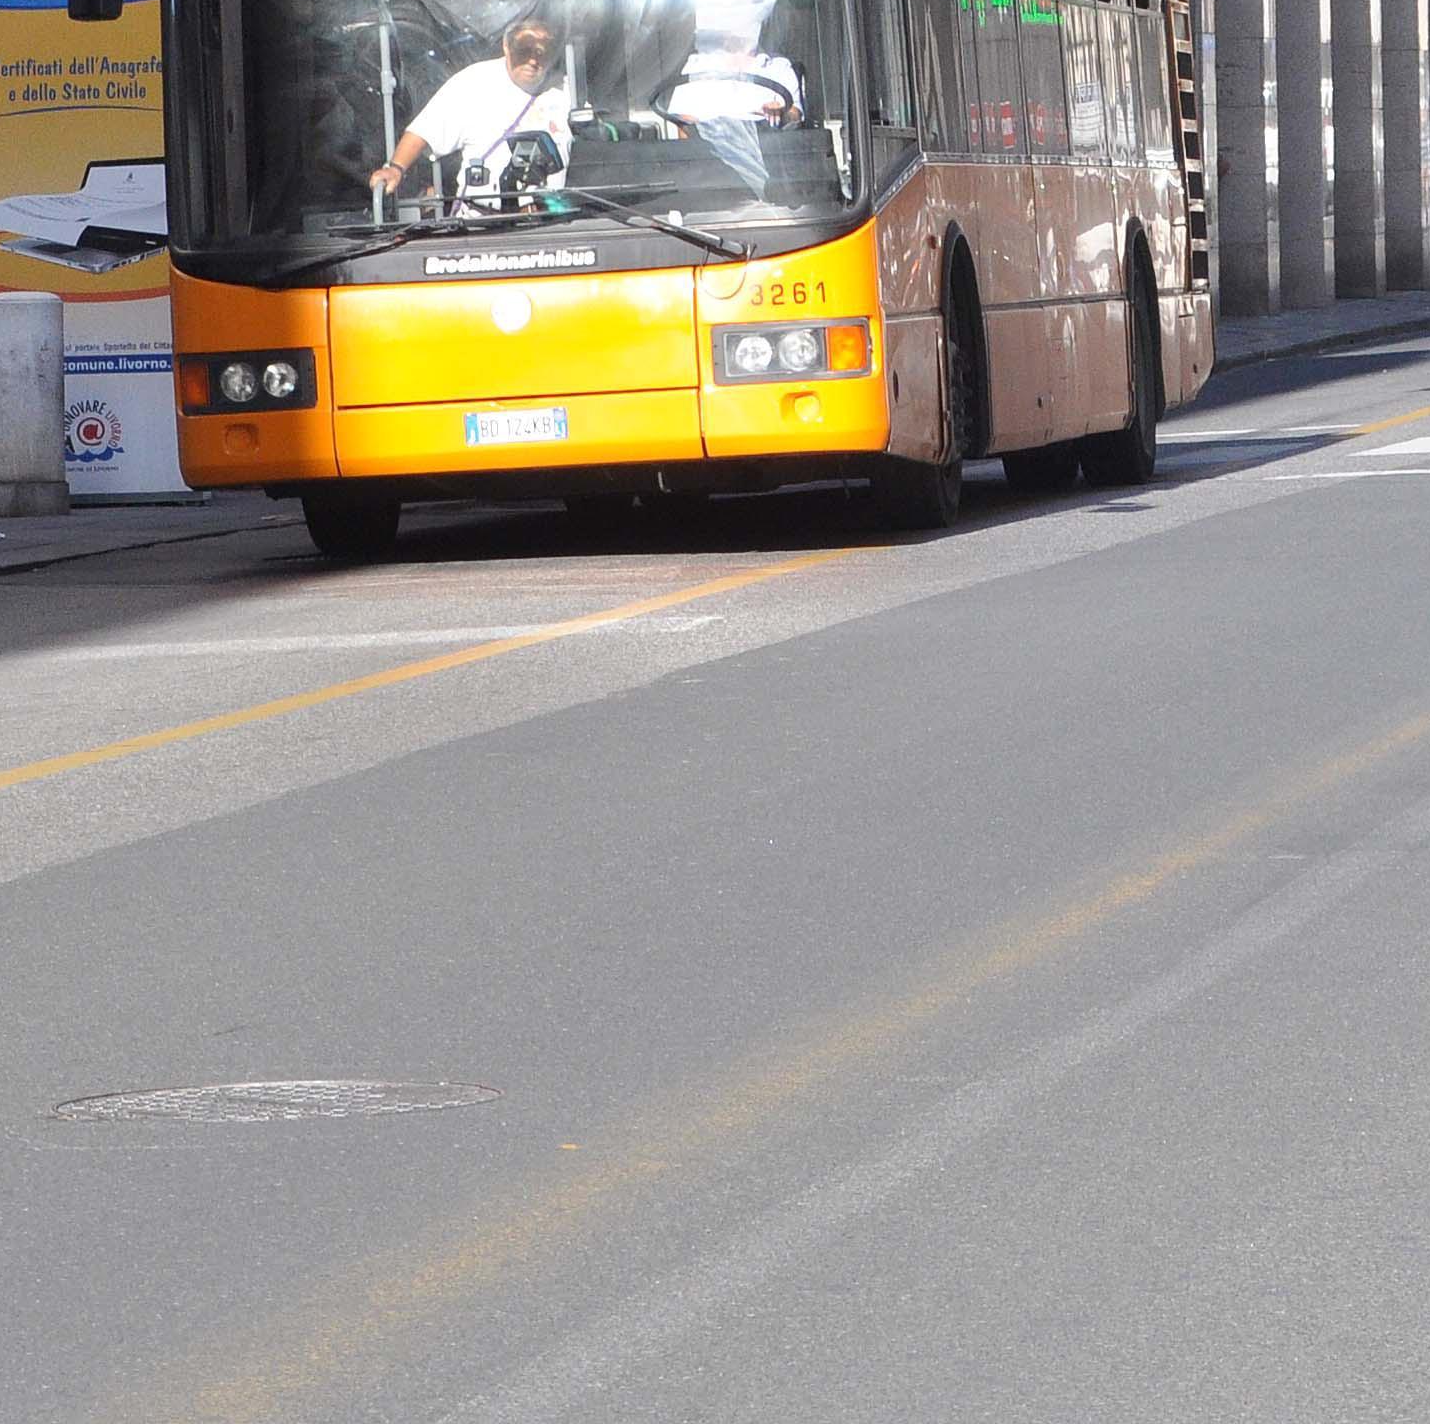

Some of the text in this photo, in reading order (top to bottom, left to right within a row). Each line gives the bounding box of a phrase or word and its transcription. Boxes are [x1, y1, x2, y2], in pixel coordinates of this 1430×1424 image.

[69, 55, 163, 79] dell'Anagrafe
[8, 80, 147, 102] e dello Stato Civile
[750, 281, 828, 306] 3261
